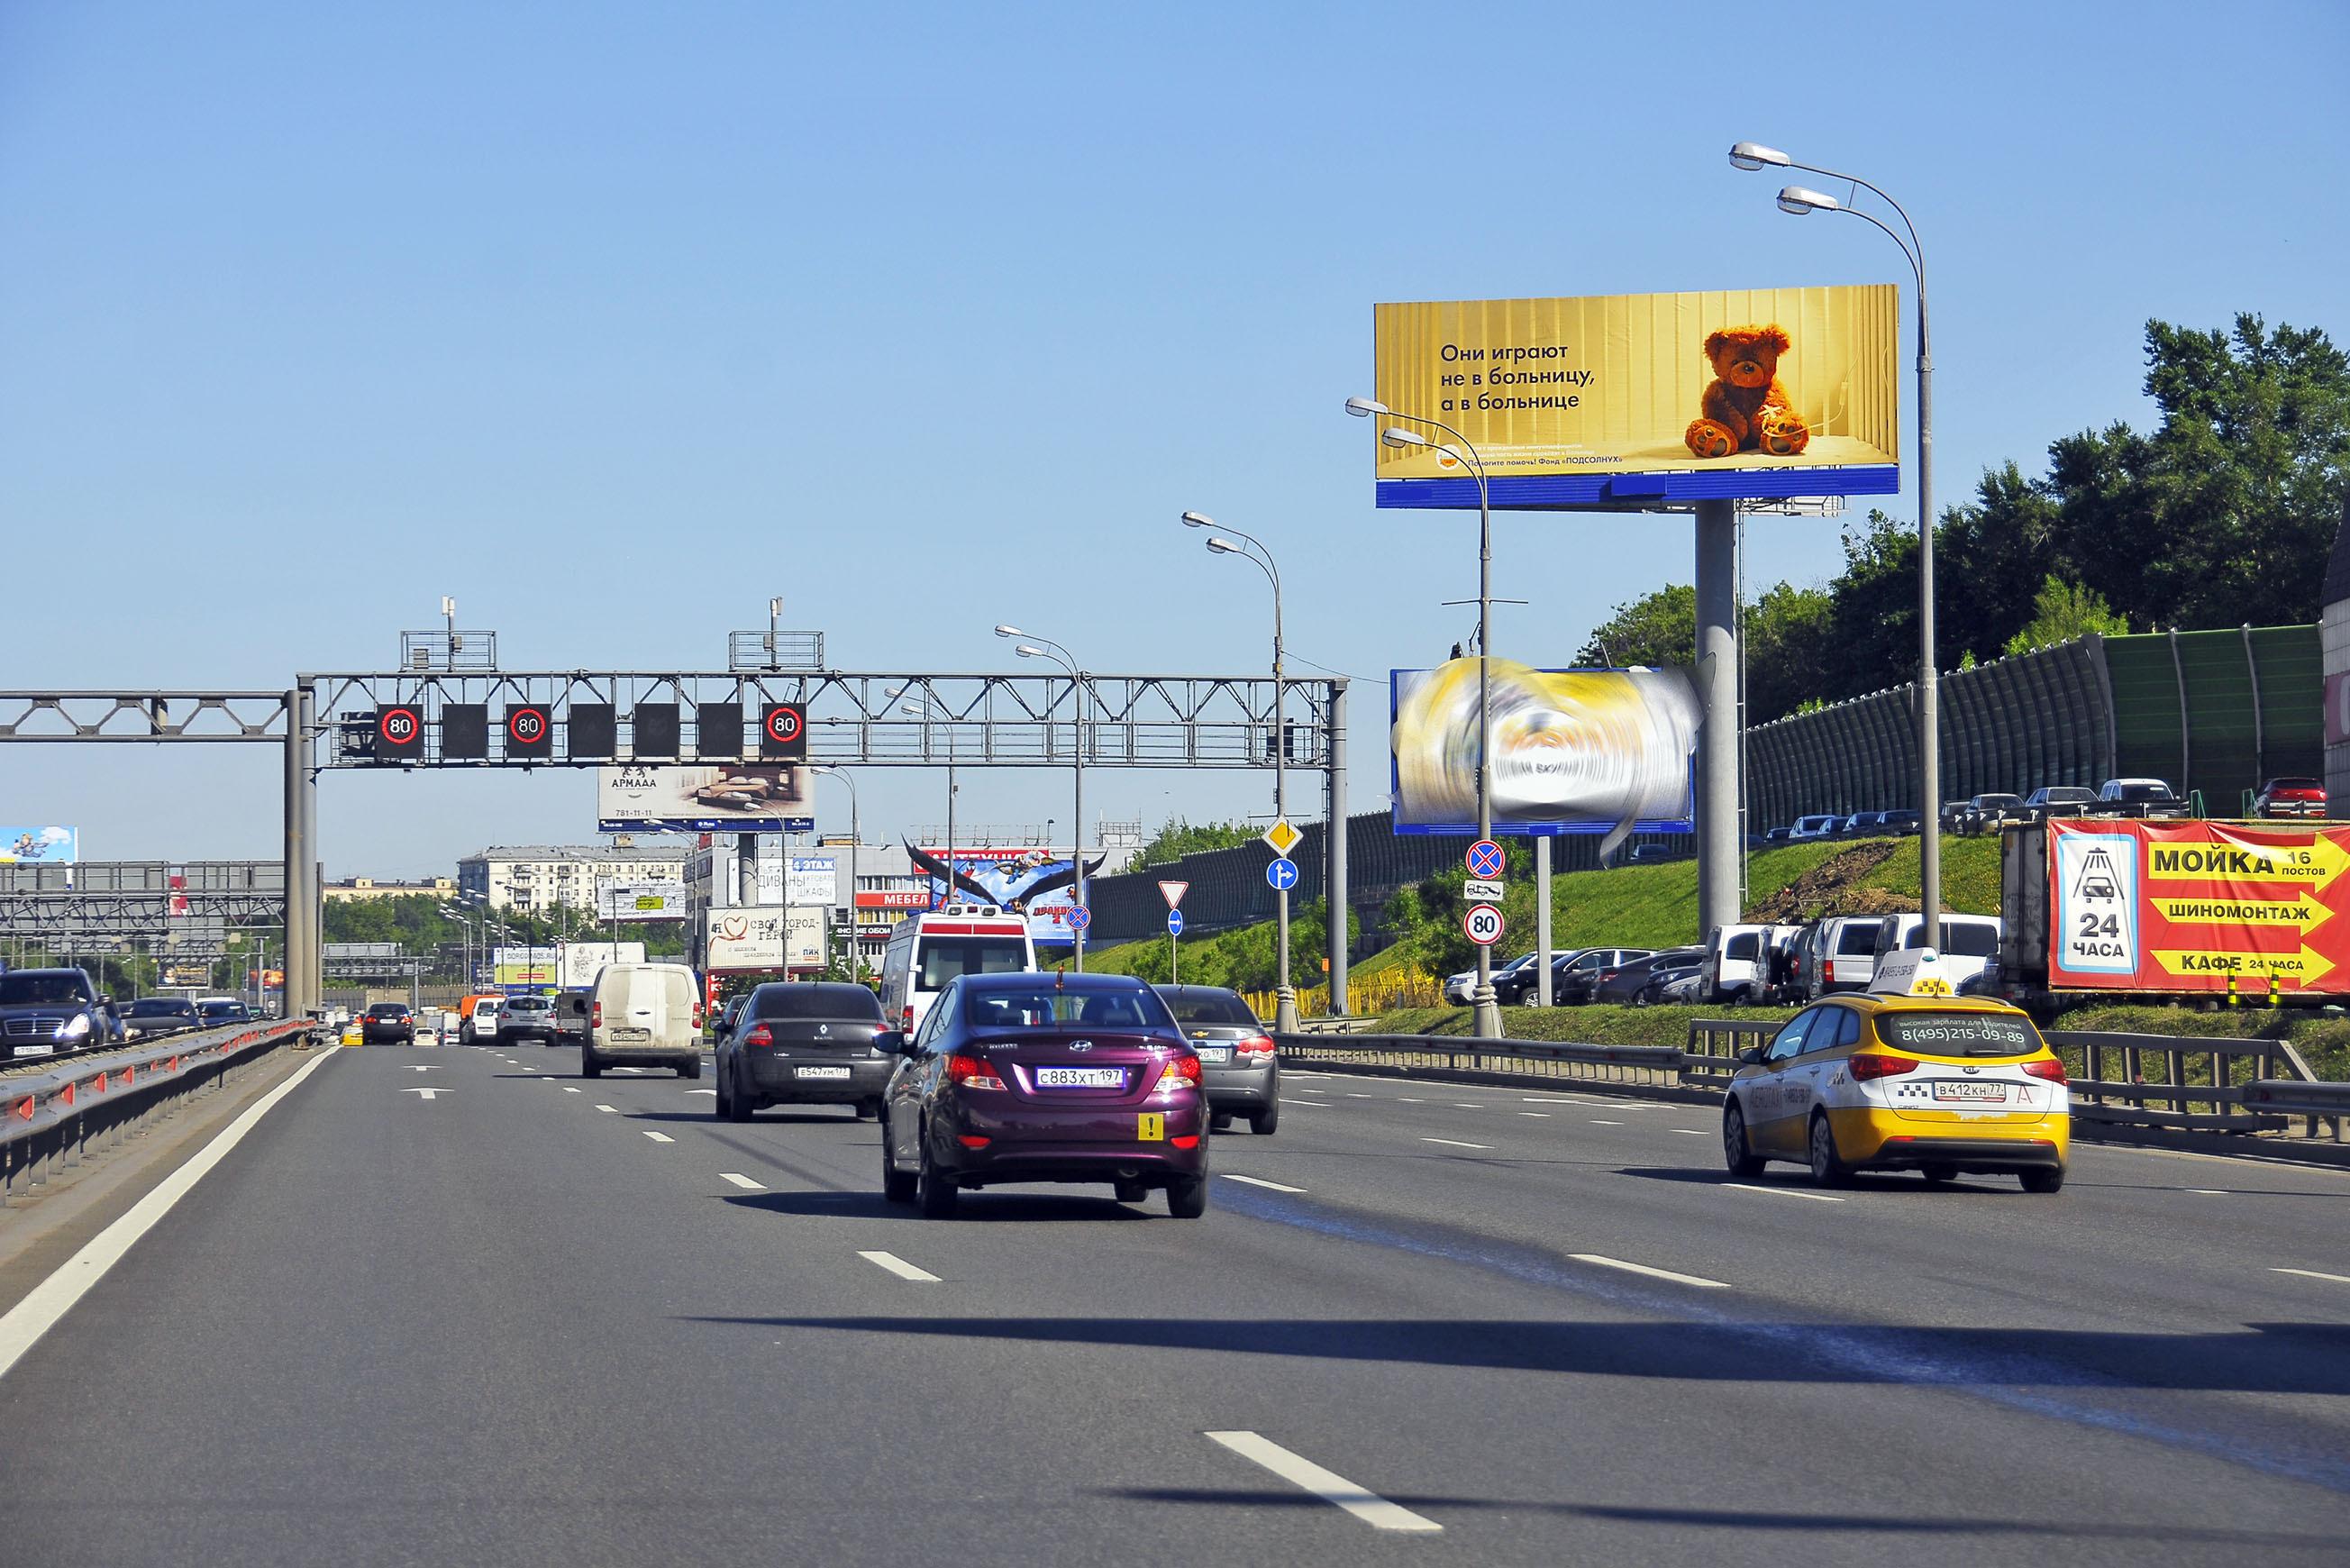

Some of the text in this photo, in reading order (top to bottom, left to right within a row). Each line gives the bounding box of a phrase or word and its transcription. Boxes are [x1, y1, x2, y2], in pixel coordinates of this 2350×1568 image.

[1441, 344, 1568, 364] Они играют
[1442, 367, 1595, 387] не в больницу,
[1441, 392, 1580, 411] а в больнице
[1506, 458, 1536, 466] помочь!
[1538, 457, 1560, 466] Фонд
[1562, 456, 1623, 465] «ПОДСОЛНУХ»
[390, 718, 411, 734] 80
[518, 718, 538, 734] 80
[775, 717, 795, 733] 80
[793, 860, 834, 870] 4 ЭТАЖ
[2154, 843, 2275, 875] МОЙКА
[2288, 851, 2311, 865] 16
[797, 887, 832, 897] ШКАФЫ
[1033, 906, 1070, 916] ДРАКО
[2169, 904, 2310, 921] ШИНОМОНТАЖ
[1052, 915, 1061, 925] 2
[1473, 916, 1496, 934] 80
[2080, 913, 2119, 938] 24
[2072, 942, 2125, 957] ЧАСА
[2181, 954, 2304, 971] КАФЕ 24 ЧАСА
[1901, 1026, 2026, 1044] 8(495)215-09-89
